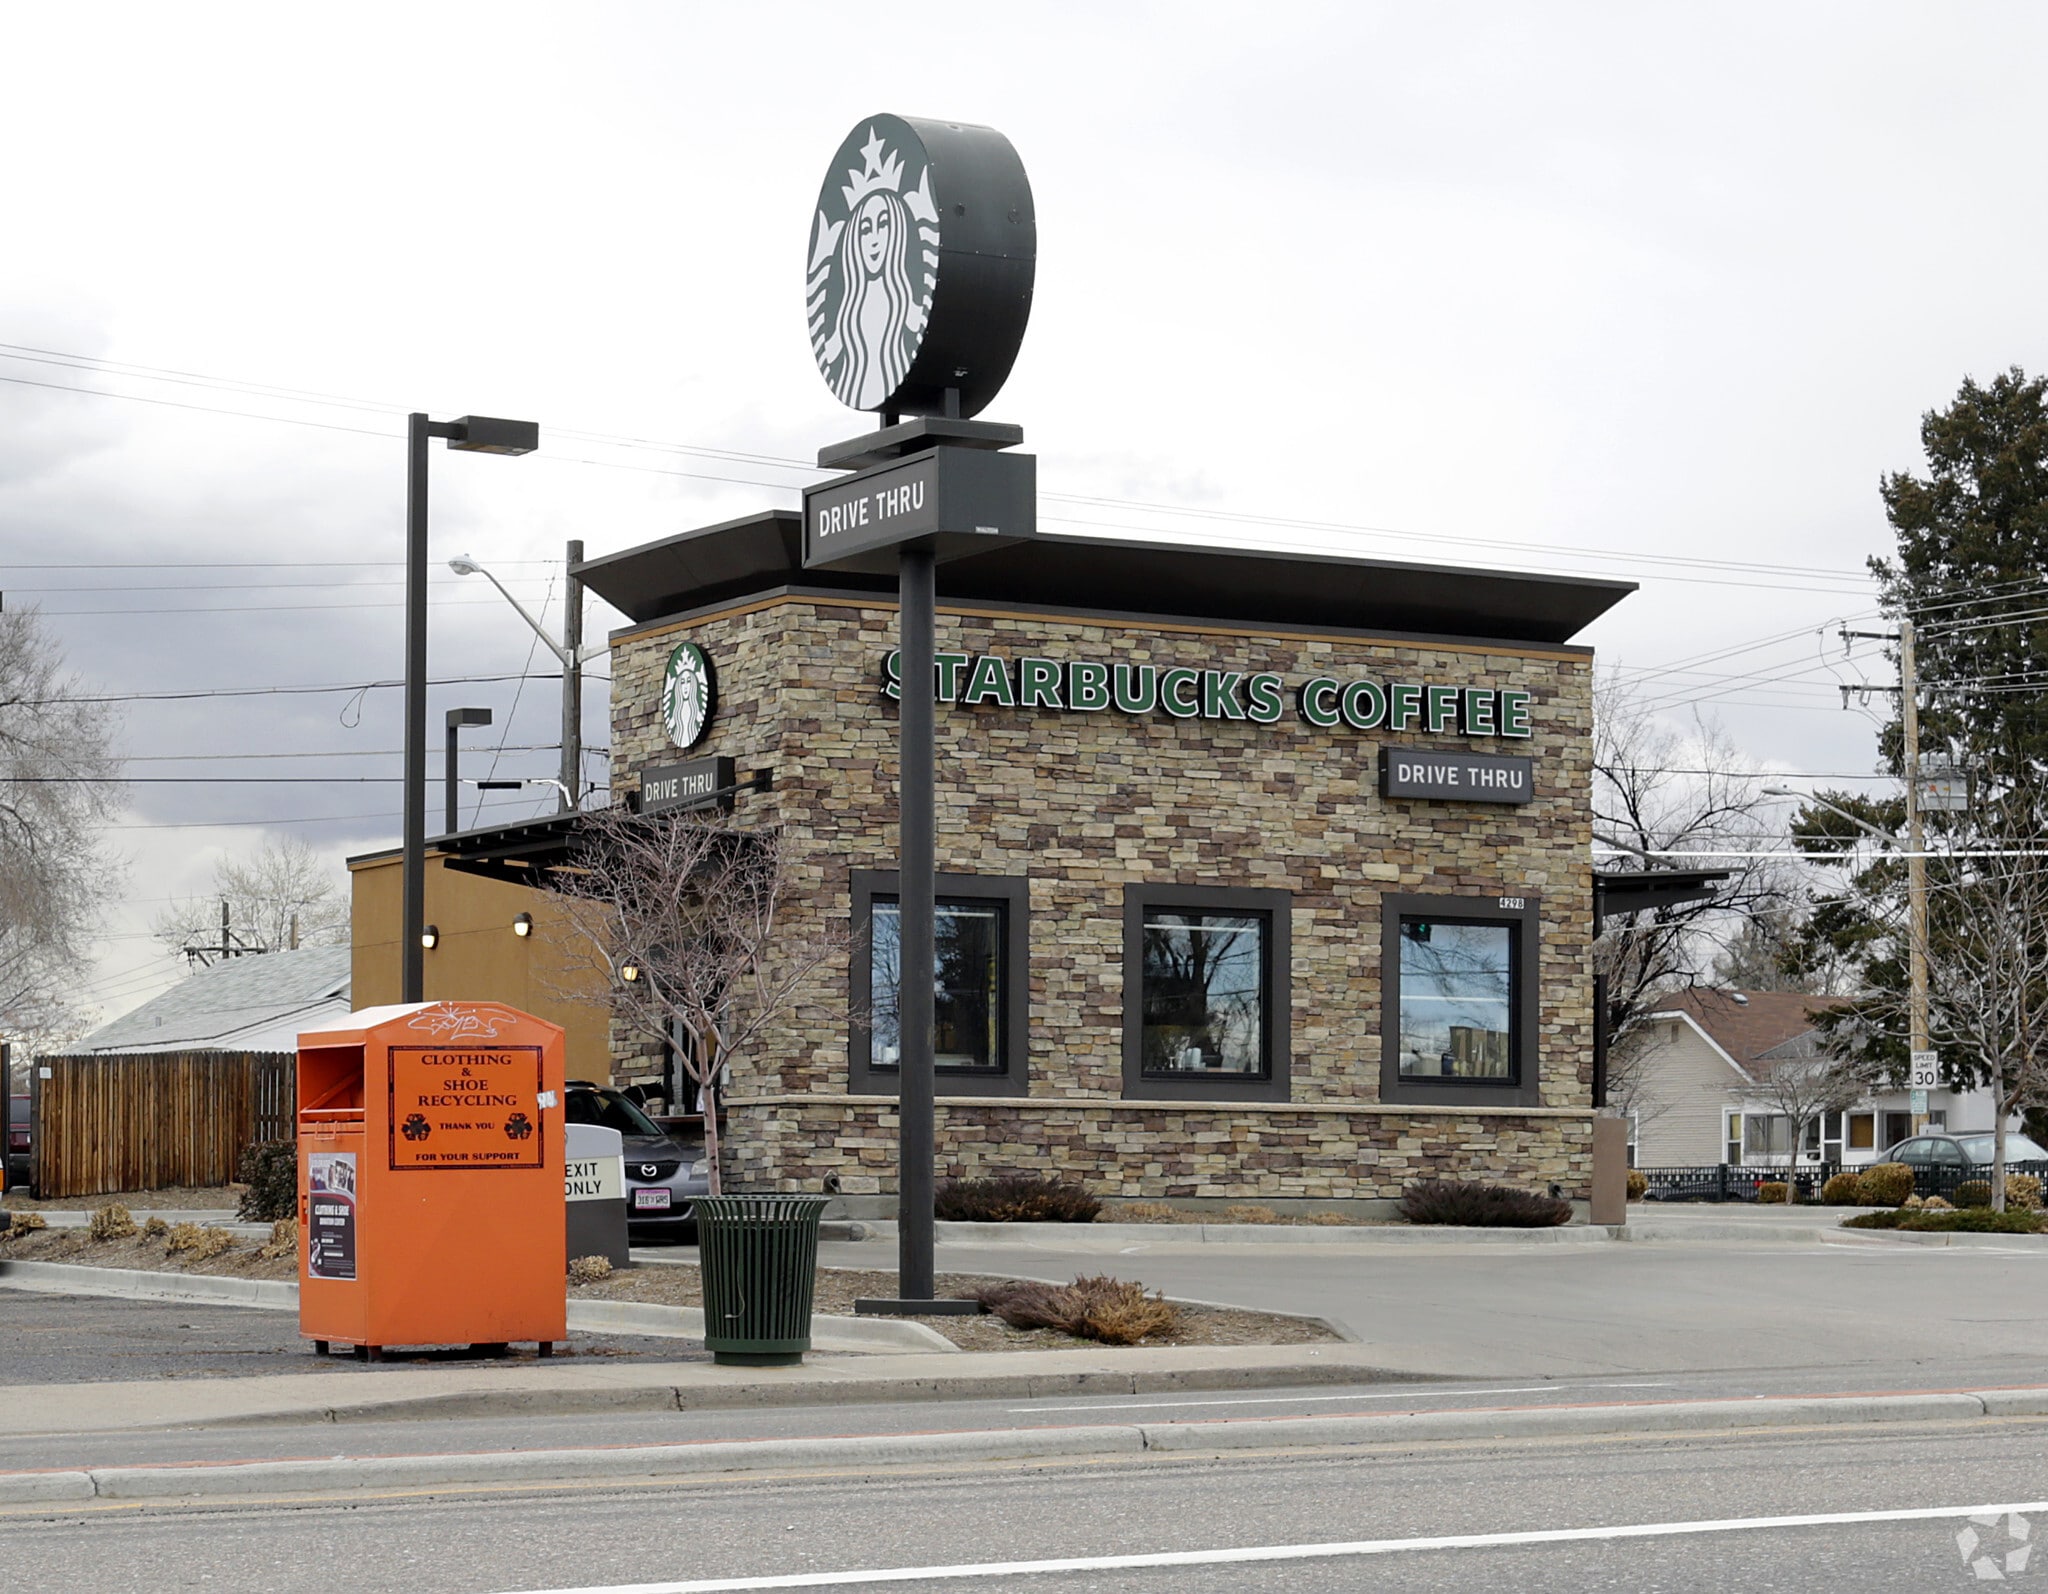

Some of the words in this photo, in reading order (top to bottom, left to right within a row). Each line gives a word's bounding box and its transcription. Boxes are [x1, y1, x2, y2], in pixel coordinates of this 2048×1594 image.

[819, 496, 869, 538] DRIVE
[876, 480, 924, 520] THRU
[1302, 677, 1531, 738] COFFEE
[1398, 763, 1459, 786] DRIVE
[1467, 766, 1524, 789] THRU
[645, 778, 678, 802] DRIVE
[682, 772, 713, 796] THRU
[1500, 898, 1523, 908] 4298
[421, 1054, 512, 1066] CLOTHING
[461, 1067, 472, 1077] &
[1915, 1071, 1935, 1086] 30
[443, 1079, 489, 1091] SHOE
[418, 1094, 517, 1107] RECYCLING
[439, 1122, 472, 1130] THANK
[475, 1122, 495, 1130] YOU
[415, 1153, 437, 1161] FOR
[440, 1153, 469, 1161] YOUR
[472, 1152, 520, 1161] SUPPORT
[565, 1162, 598, 1178] EXIT
[565, 1180, 602, 1196] ONLY
